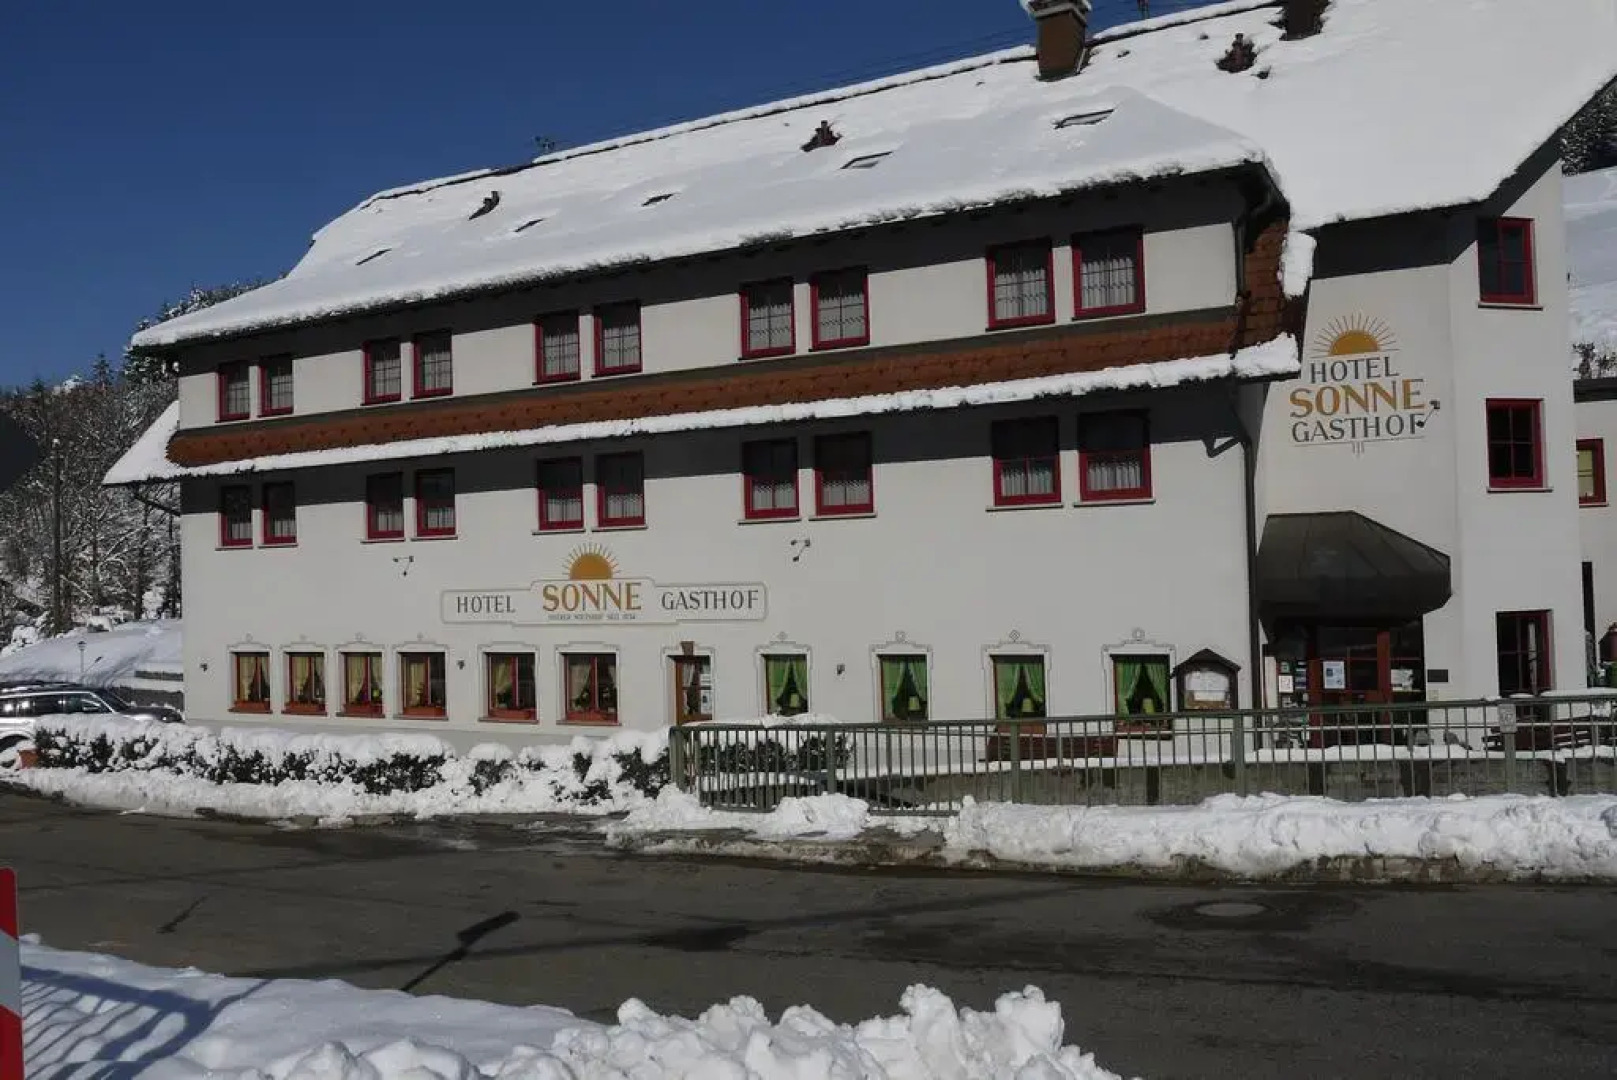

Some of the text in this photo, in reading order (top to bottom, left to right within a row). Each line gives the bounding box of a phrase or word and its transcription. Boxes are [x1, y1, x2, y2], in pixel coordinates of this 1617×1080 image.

[1310, 356, 1400, 384] HOTEL
[1289, 378, 1426, 418] SONNE
[1291, 413, 1426, 443] GASTHOF
[456, 583, 759, 614] HOTEL SONNE GASTHOF
